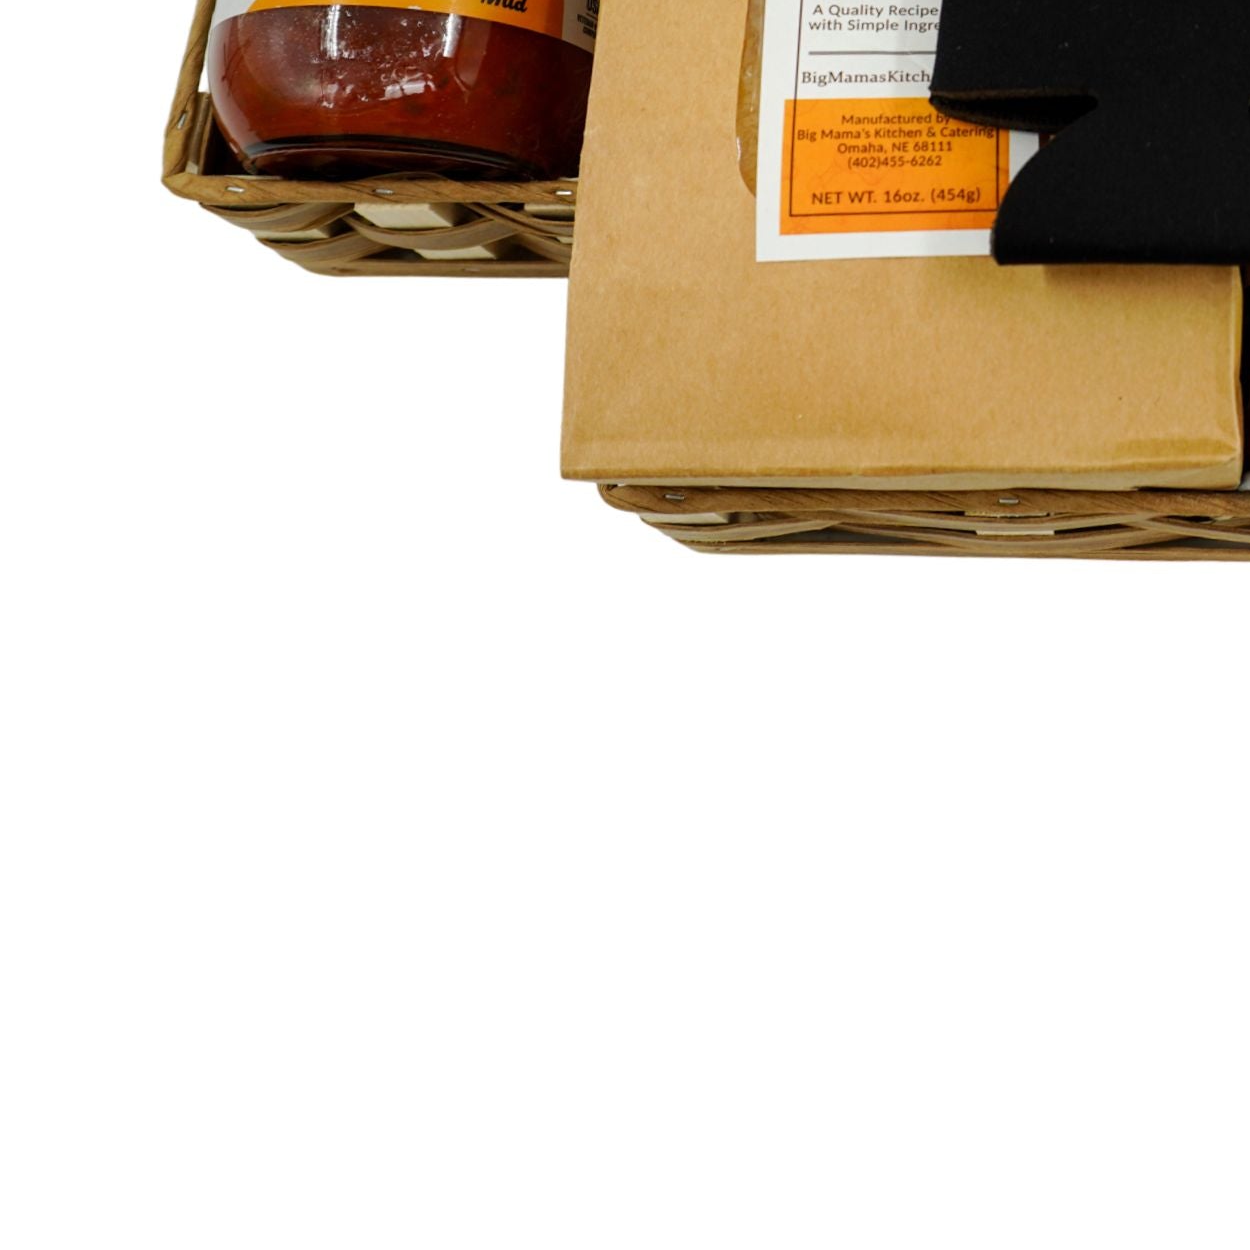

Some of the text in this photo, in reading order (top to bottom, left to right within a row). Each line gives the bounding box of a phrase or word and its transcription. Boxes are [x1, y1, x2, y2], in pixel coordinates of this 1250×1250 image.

[812, 4, 939, 18] A Quality Recipe
[808, 19, 940, 33] with Simple Ingre
[801, 69, 931, 87] BigMamasKitch
[841, 113, 950, 127] Manufactured by
[796, 126, 995, 142] Big Mama's Kitchen & Catering
[837, 141, 953, 155] Omaha, NE 68111
[847, 155, 943, 170] (402)455-6262
[811, 187, 981, 205] NET WT. 16oz. (454g)
